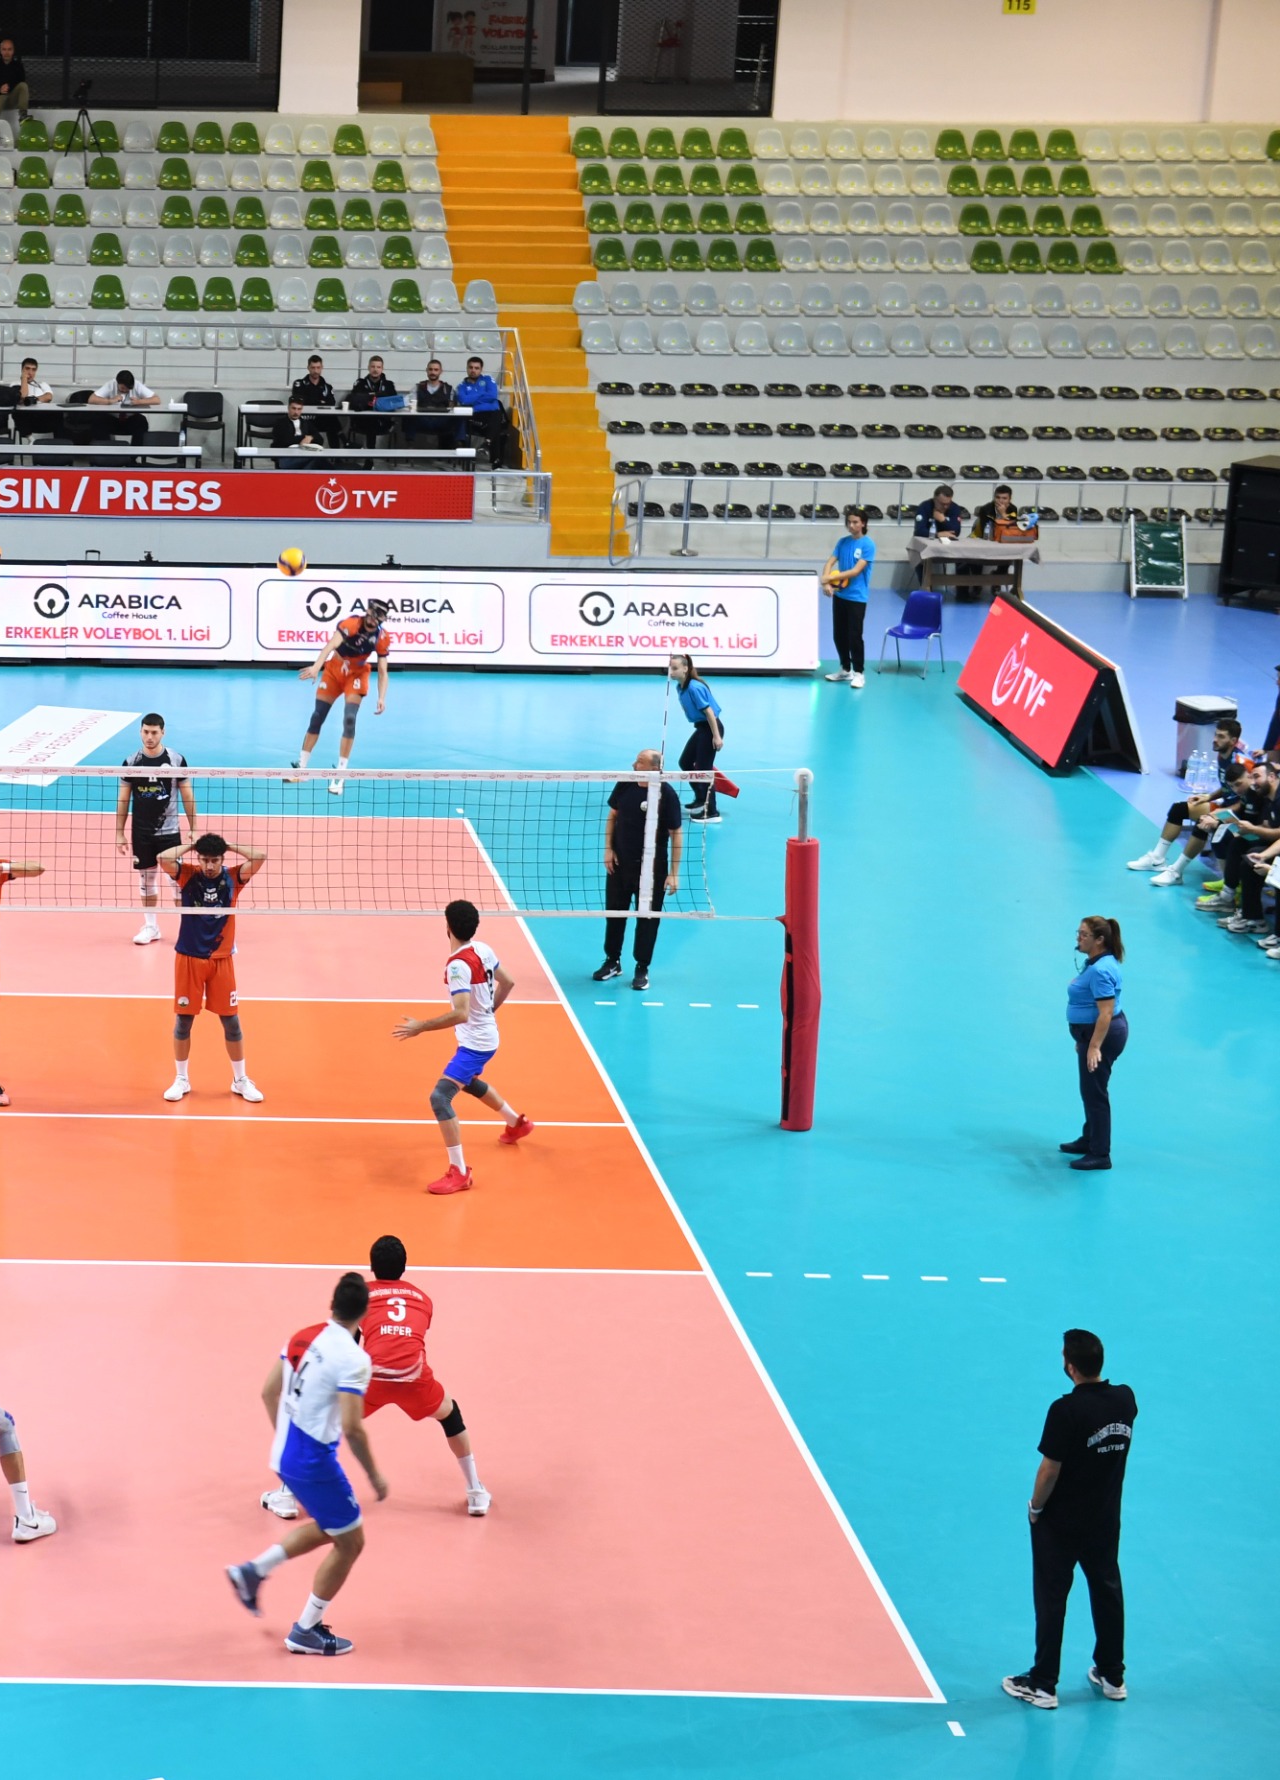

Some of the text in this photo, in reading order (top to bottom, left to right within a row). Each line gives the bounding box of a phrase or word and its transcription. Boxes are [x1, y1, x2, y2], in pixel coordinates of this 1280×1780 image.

[482, 28, 538, 39] VOLEYBL
[99, 479, 221, 512] PRESS
[353, 490, 397, 509] TVF
[78, 594, 182, 609] ARABICA
[350, 598, 455, 613] AABICA
[624, 602, 728, 617] ARABICA
[5, 626, 210, 640] ERKEKLER VOLEYBOL 1. LİGİ
[278, 630, 483, 645] ERKEKL EYBOL 1. LİGİ
[551, 633, 757, 648] ERKEKLER VOLEYBOL 1. LİGİ
[1013, 666, 1053, 717] TVF
[387, 1298, 406, 1322] 3
